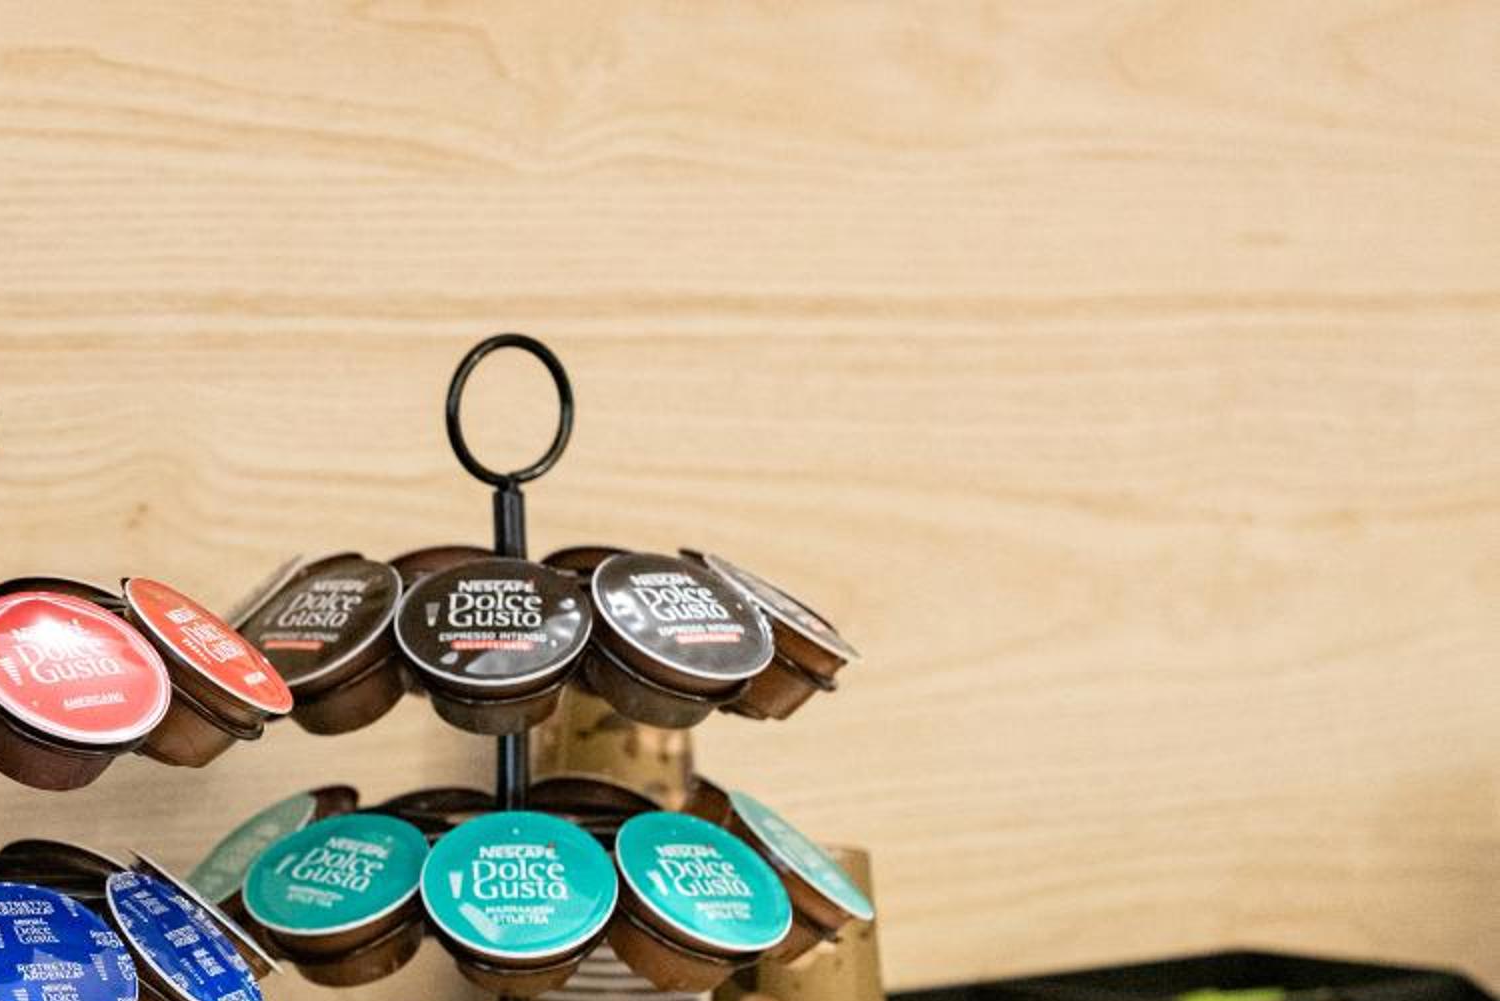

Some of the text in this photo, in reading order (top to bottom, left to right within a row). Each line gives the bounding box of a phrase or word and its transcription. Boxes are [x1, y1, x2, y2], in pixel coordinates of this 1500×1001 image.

[449, 591, 542, 612] Dolce
[633, 584, 718, 606] Dolce
[448, 609, 542, 627] Gusto
[649, 602, 729, 620] Gusto
[30, 657, 125, 684] Gusto
[303, 847, 384, 876] Dolce
[472, 858, 565, 881] Dolce
[659, 857, 738, 880] Dolce
[291, 864, 371, 892] Gusto
[473, 878, 569, 900] Gusto
[673, 875, 753, 897] Gusto
